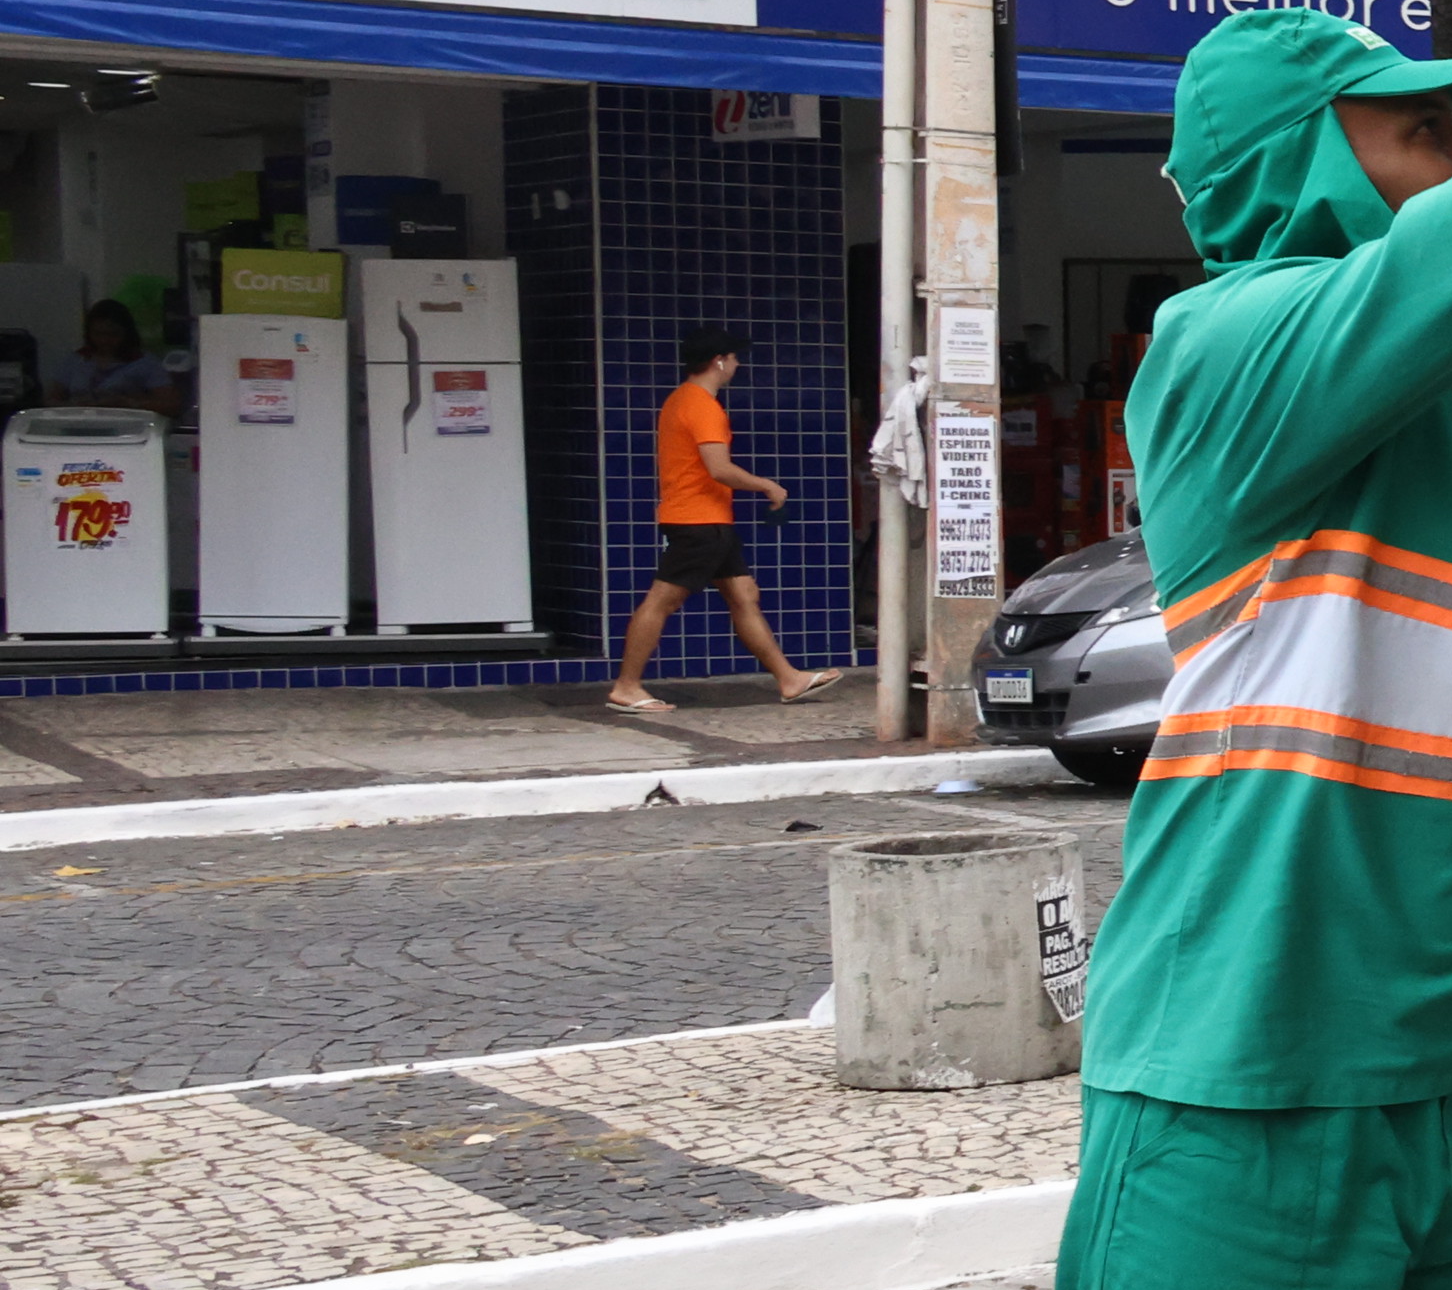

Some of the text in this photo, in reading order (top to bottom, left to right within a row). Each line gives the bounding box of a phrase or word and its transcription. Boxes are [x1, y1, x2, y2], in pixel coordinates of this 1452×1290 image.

[939, 438, 992, 450] ESPÍRITA
[941, 451, 989, 462] VIDENTE
[985, 479, 992, 489] E
[940, 490, 992, 500] I-CHING
